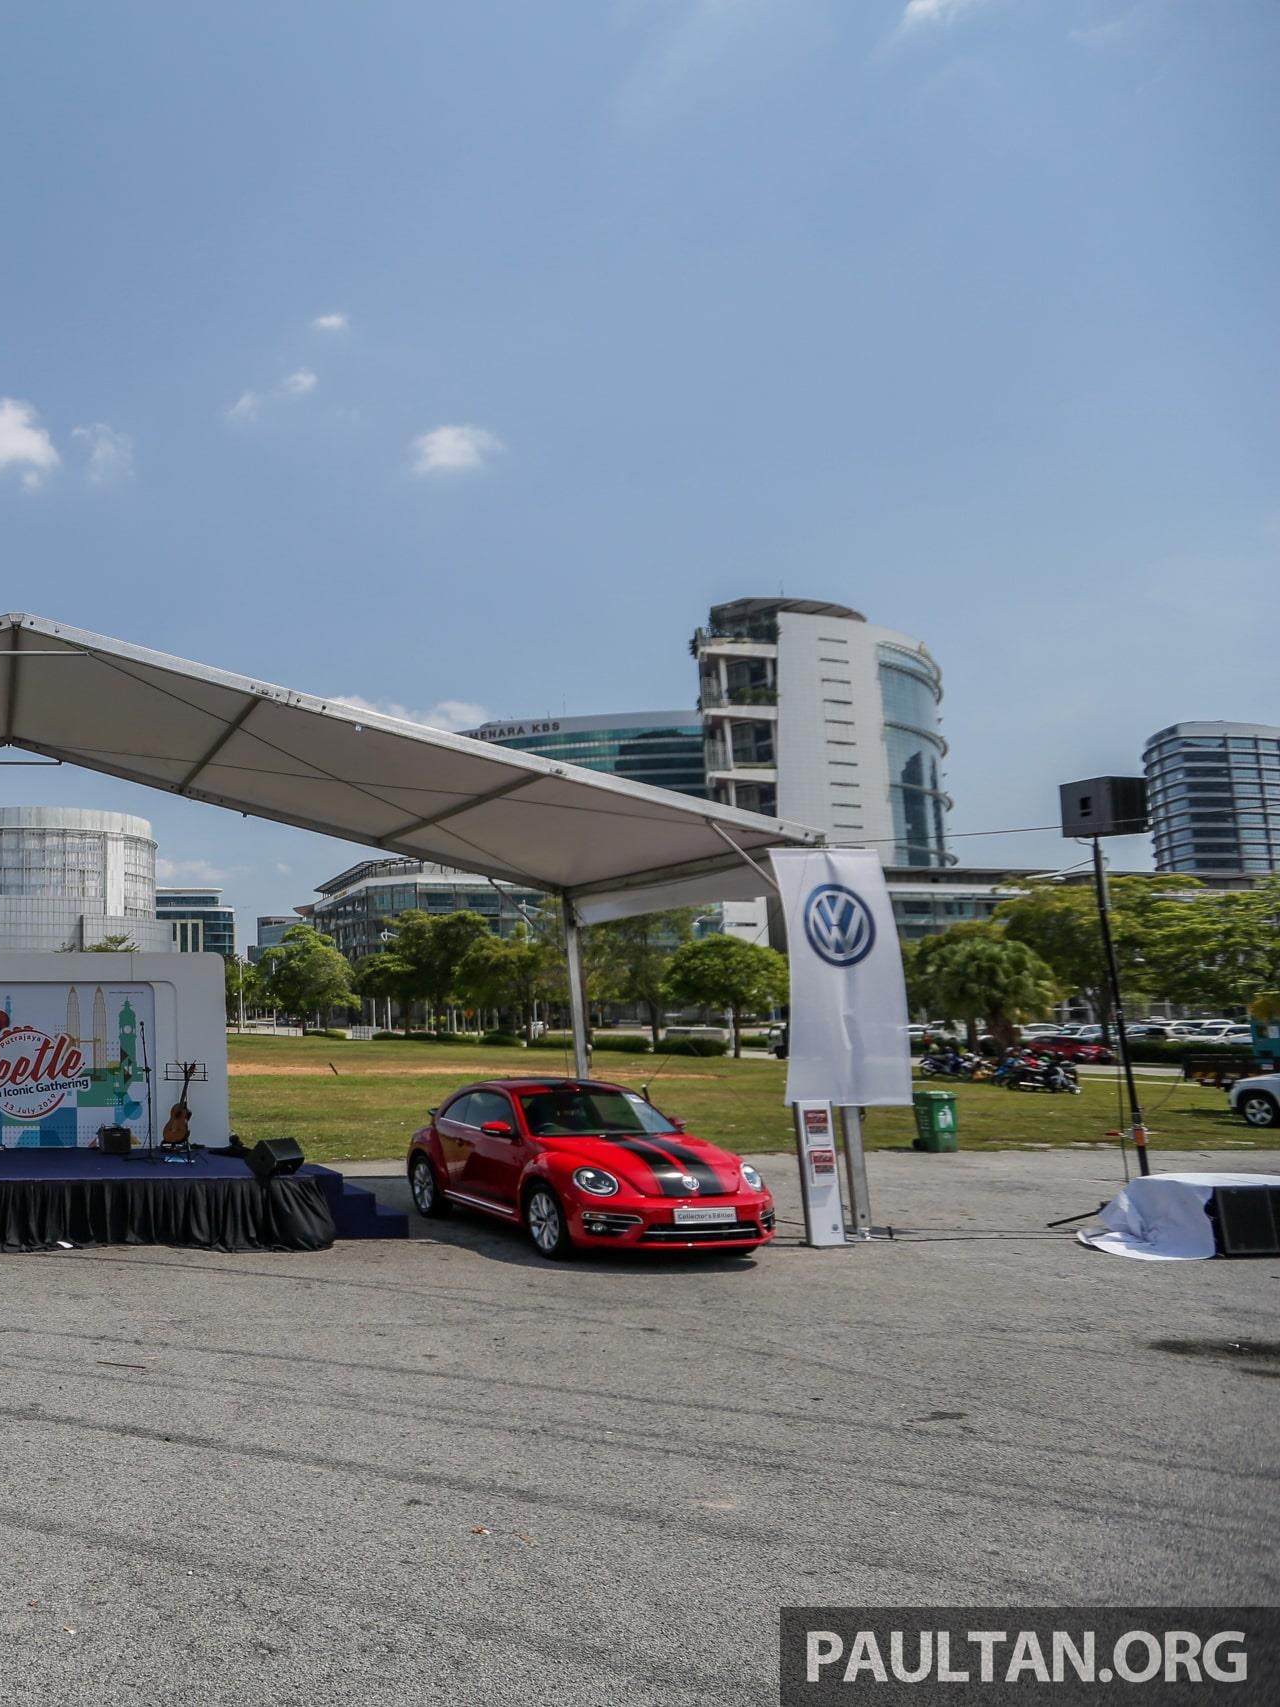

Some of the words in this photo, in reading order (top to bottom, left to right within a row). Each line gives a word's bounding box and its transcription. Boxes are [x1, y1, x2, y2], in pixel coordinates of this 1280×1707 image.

[531, 721, 560, 734] KBS
[0, 1033, 42, 1049] Putrajaya
[4, 1084, 34, 1097] Iconic
[35, 1079, 89, 1094] Gathering
[3, 1101, 15, 1111] 13
[17, 1106, 36, 1115] July
[38, 1093, 57, 1110] 2019
